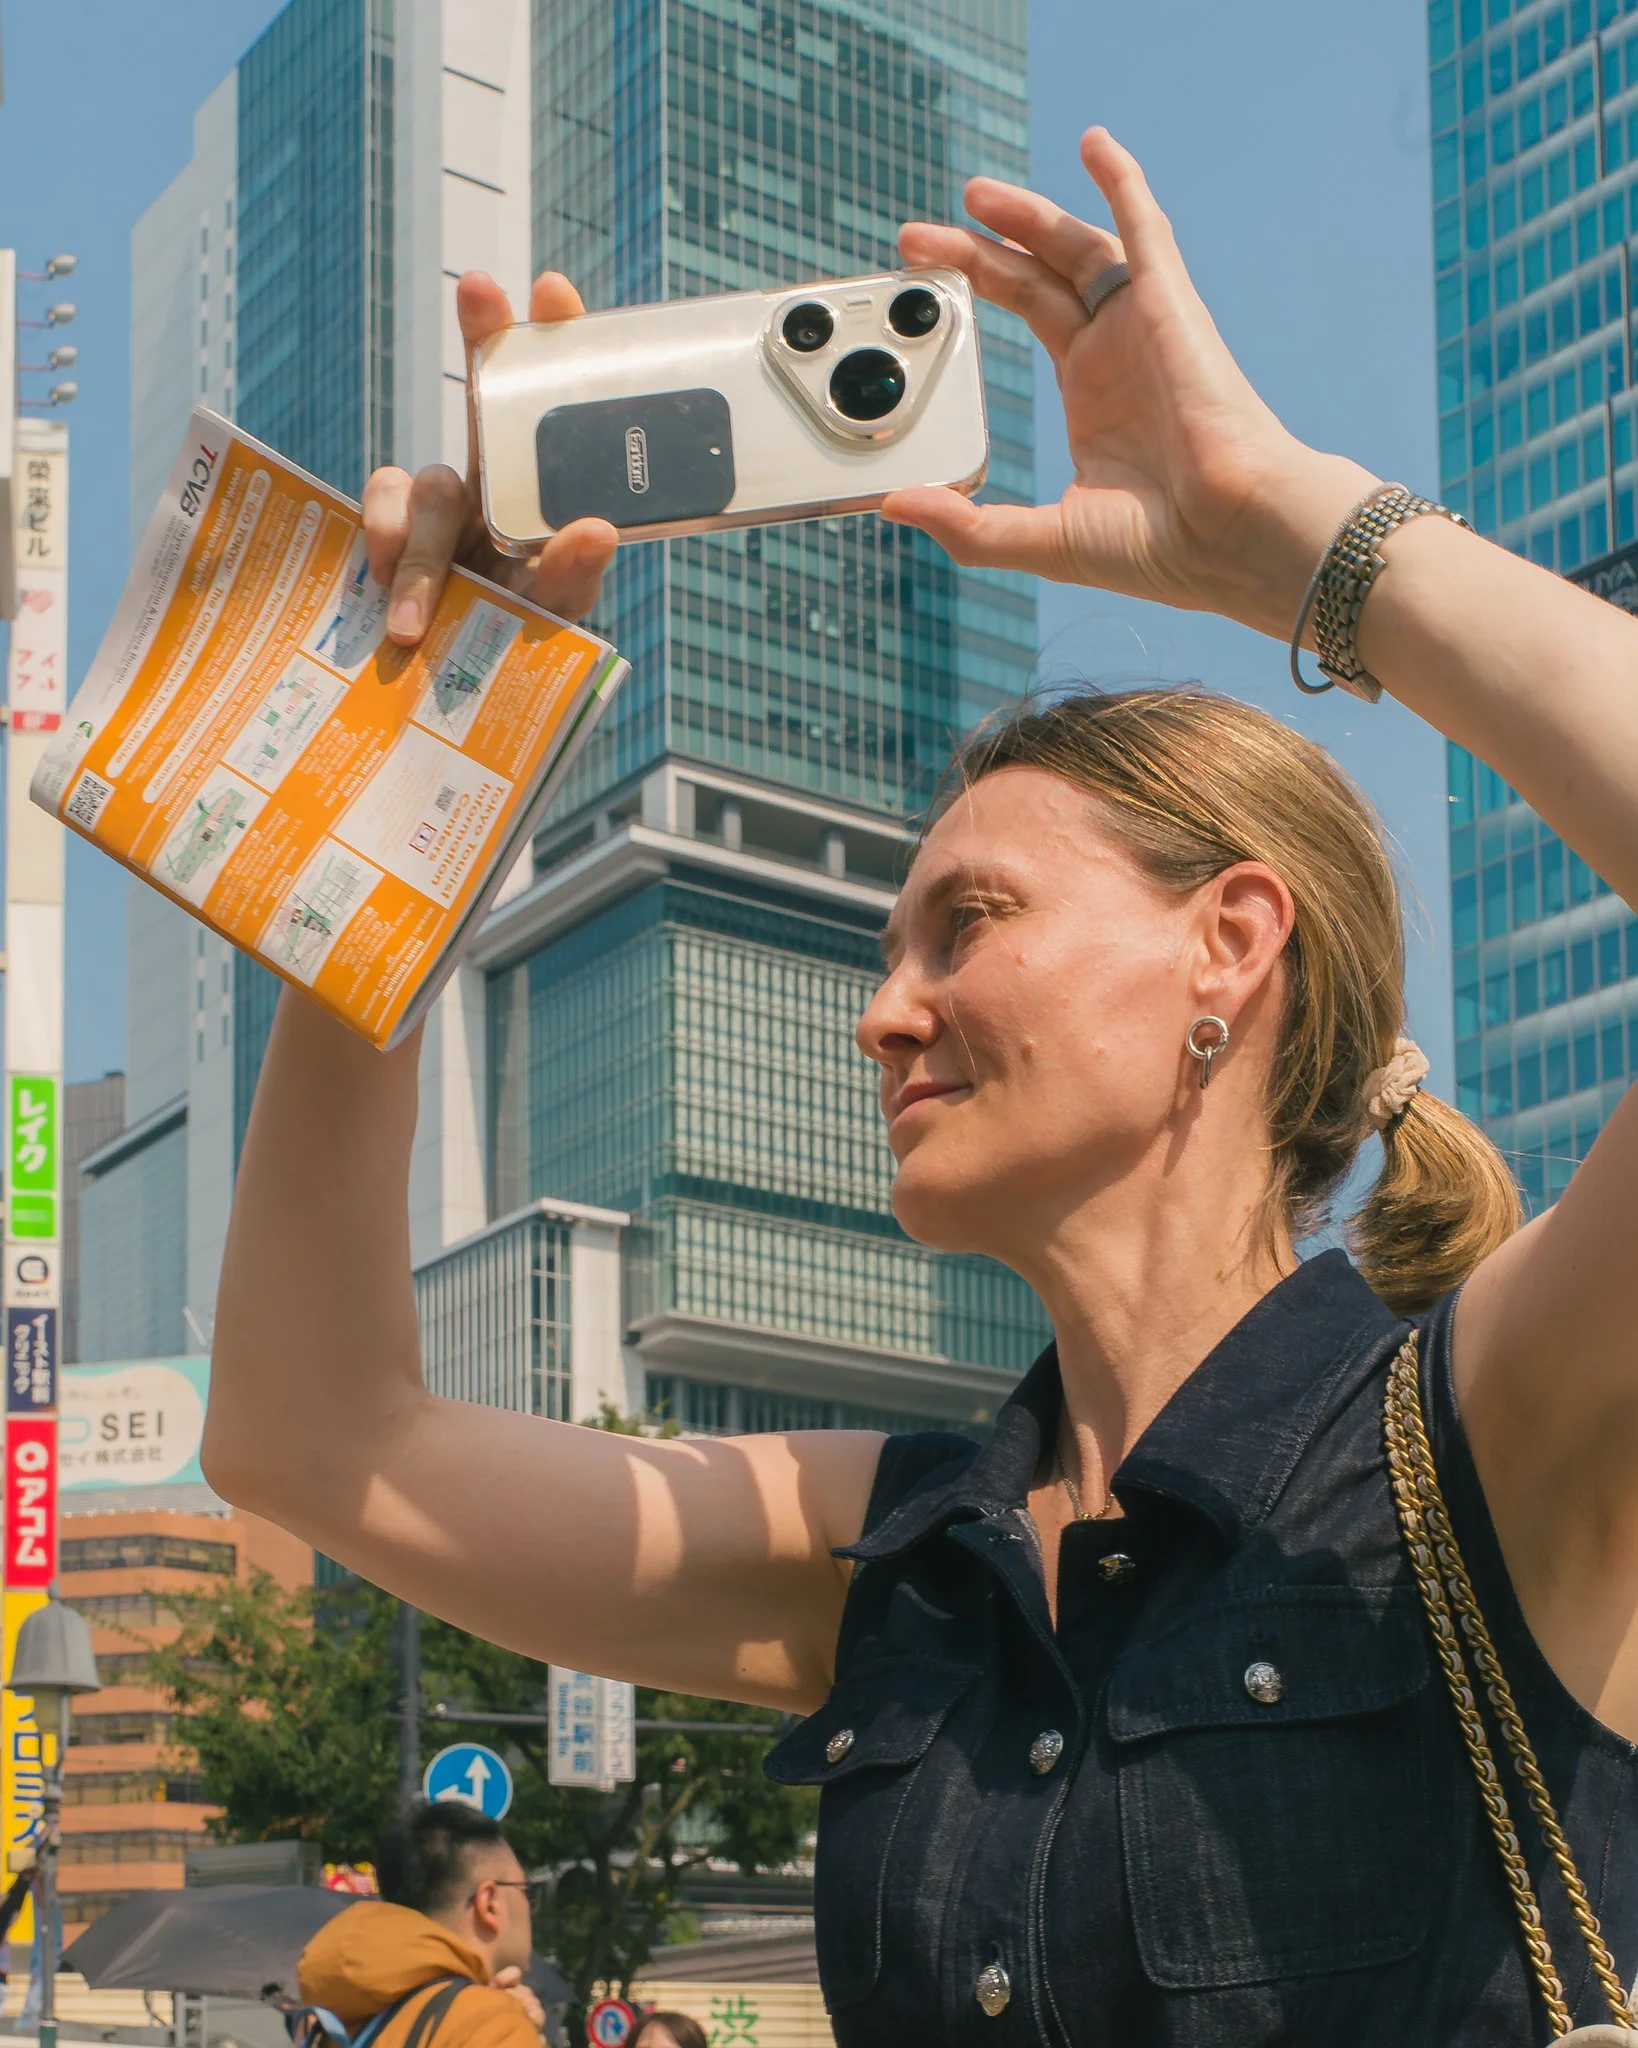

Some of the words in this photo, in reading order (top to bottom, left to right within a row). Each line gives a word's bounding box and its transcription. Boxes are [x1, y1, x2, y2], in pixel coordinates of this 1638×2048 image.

[177, 444, 218, 517] TCVB
[277, 528, 309, 590] Japanese
[208, 587, 224, 610] The
[184, 611, 213, 657] Official
[245, 591, 283, 656] Prefectural
[273, 638, 294, 663] Tokyo
[163, 659, 189, 693] Tokyo
[217, 657, 250, 698] Tourism
[234, 679, 257, 703] Tokyo
[140, 694, 168, 729] Travel
[179, 698, 221, 753] Promotion
[114, 730, 142, 764] Guide
[183, 751, 206, 775] Tokyo
[150, 754, 181, 792] Corner
[427, 792, 471, 863] Centers
[430, 781, 491, 887] Information
[472, 785, 505, 837] Tokyo
[439, 841, 477, 899] Tourist
[17, 1089, 47, 1173] レイク
[102, 1411, 163, 1441] SEI
[16, 1477, 47, 1566] アコム
[709, 1994, 760, 2046] 渋
